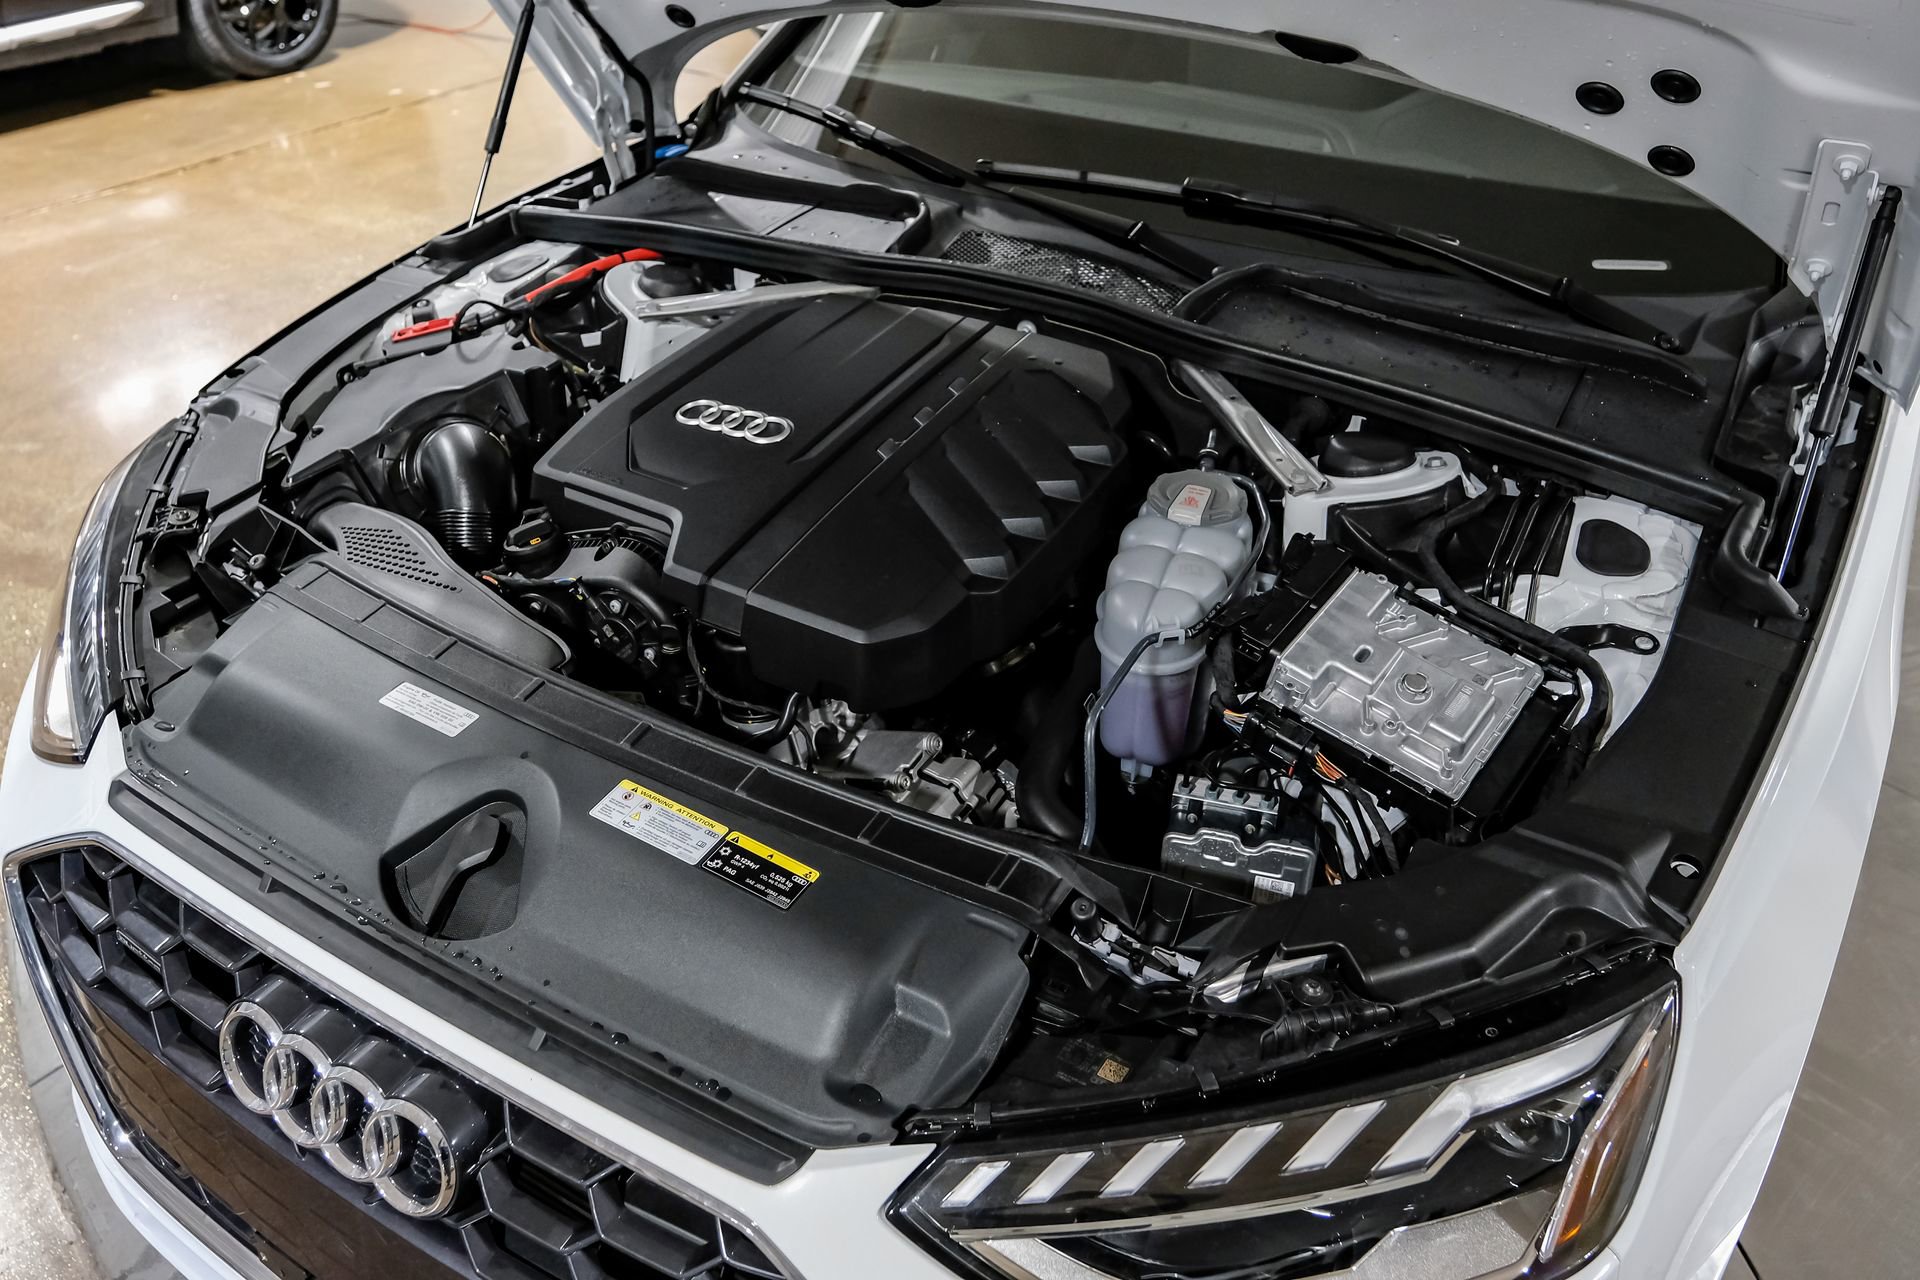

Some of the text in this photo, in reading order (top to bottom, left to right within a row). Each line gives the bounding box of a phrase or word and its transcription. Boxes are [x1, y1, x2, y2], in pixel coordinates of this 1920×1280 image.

[640, 790, 674, 809] WARNING
[676, 808, 716, 829] ATTENTION
[733, 854, 760, 870] R-1234yf
[722, 865, 737, 875] PAG
[784, 880, 794, 888] kg
